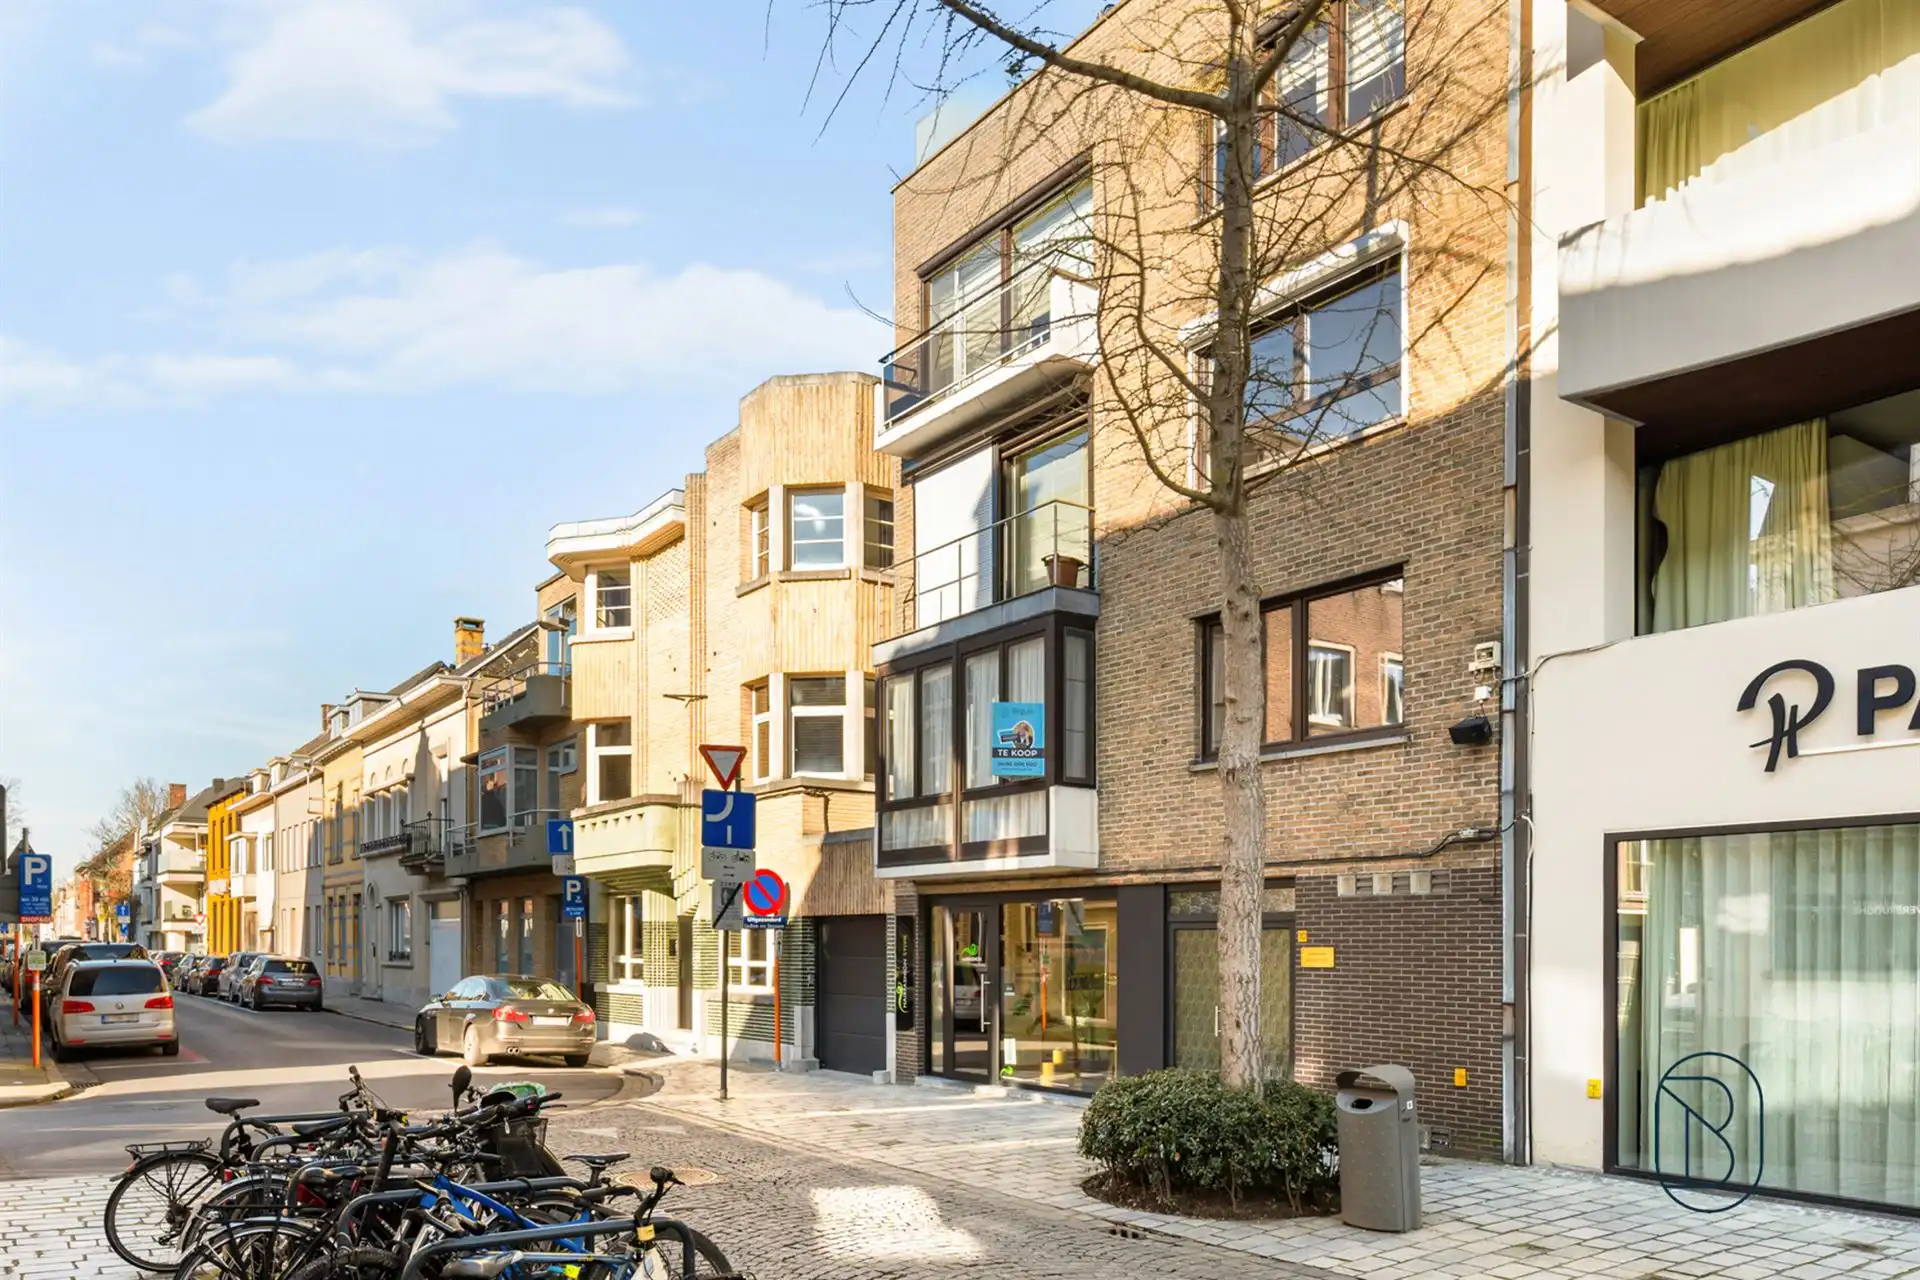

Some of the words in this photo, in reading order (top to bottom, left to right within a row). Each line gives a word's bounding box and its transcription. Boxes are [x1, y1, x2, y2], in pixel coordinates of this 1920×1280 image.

[1857, 664, 1920, 735] P
[997, 749, 1009, 757] TE
[1011, 749, 1038, 757] KOOP
[24, 857, 48, 885] P
[566, 880, 581, 901] P
